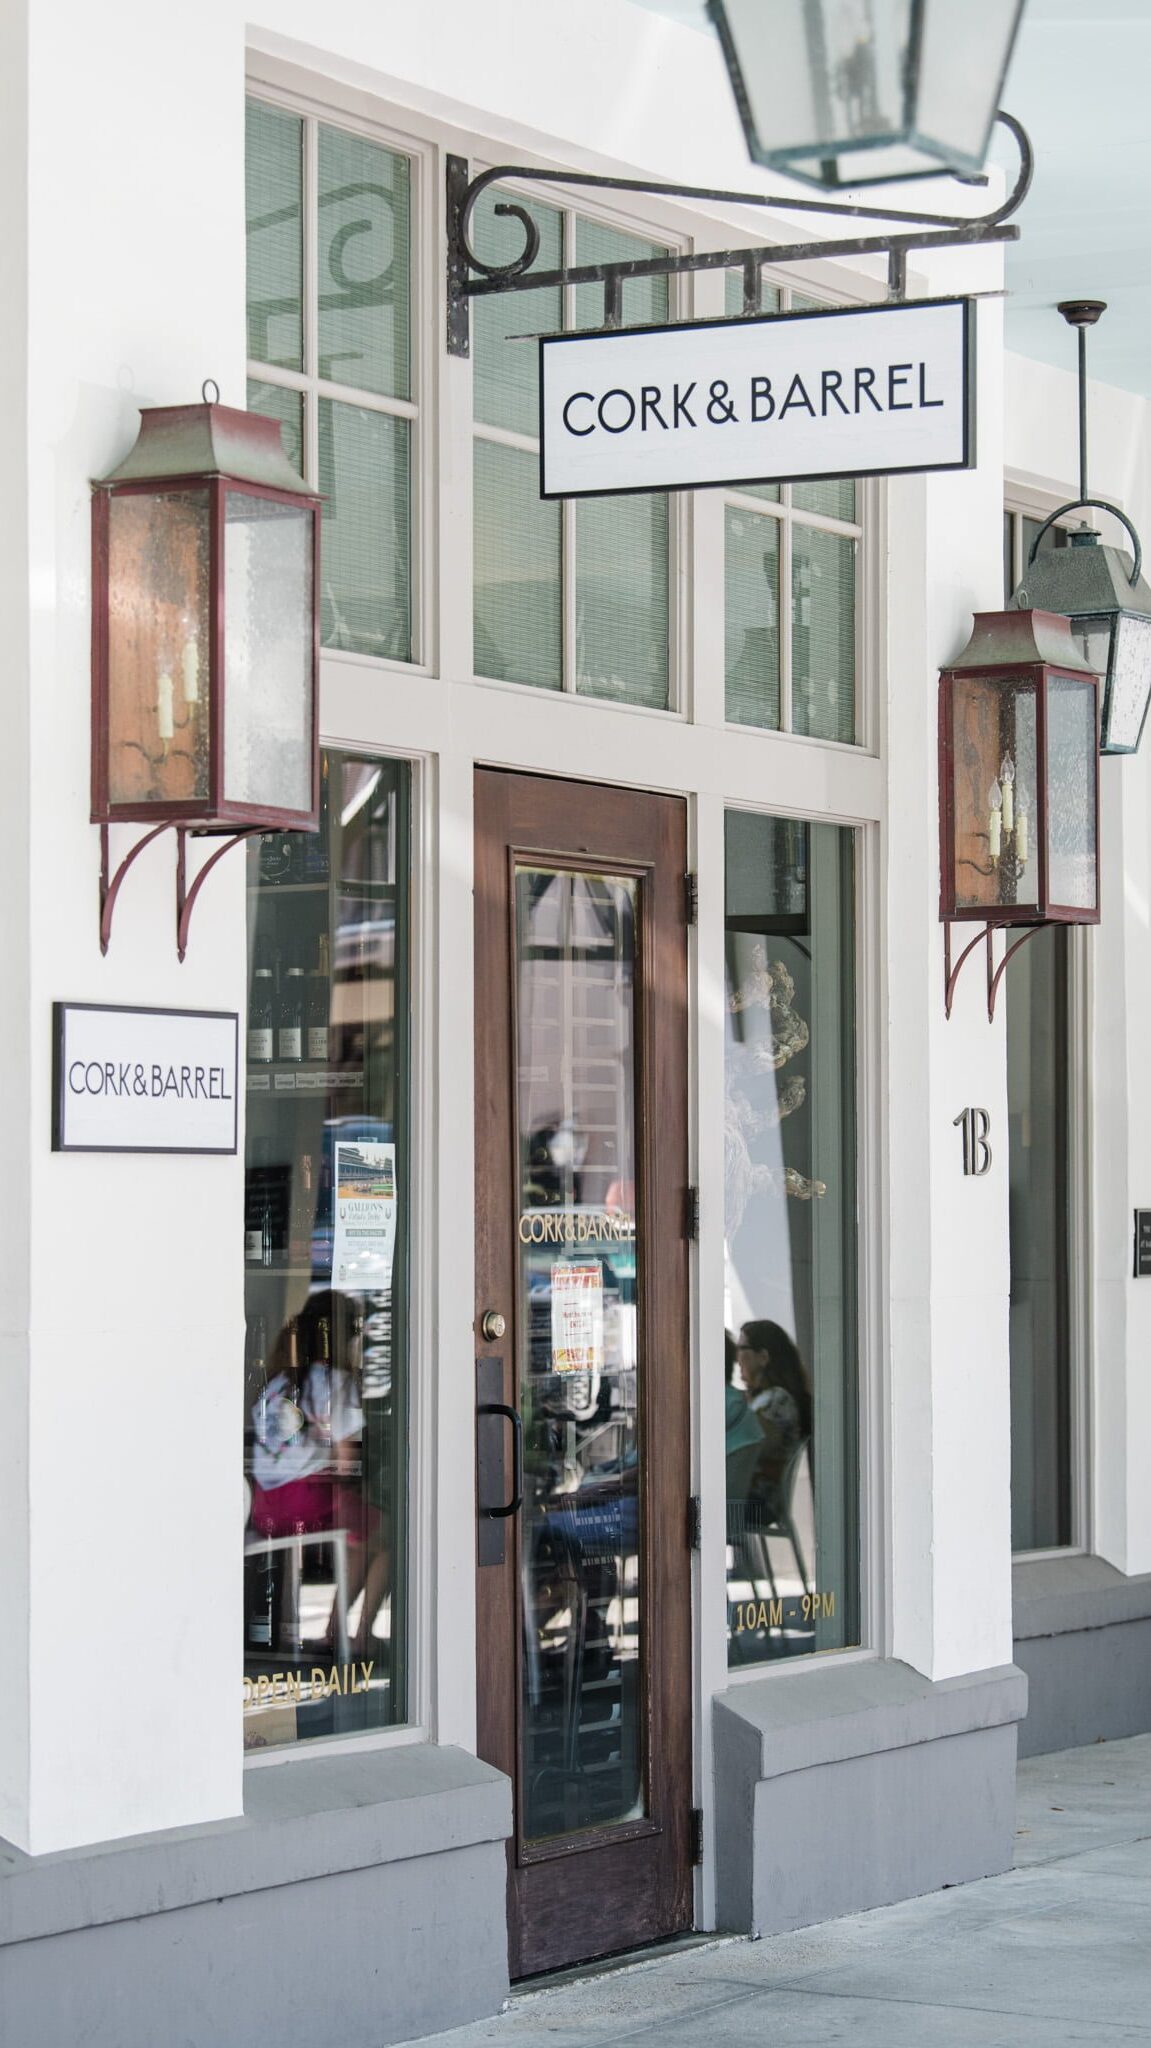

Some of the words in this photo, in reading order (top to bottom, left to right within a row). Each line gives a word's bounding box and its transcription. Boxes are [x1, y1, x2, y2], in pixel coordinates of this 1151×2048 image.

[952, 1107, 993, 1176] 1B
[736, 1598, 783, 1632] 10AM
[801, 1591, 835, 1622] 9PM
[311, 1660, 374, 1700] DAILY
